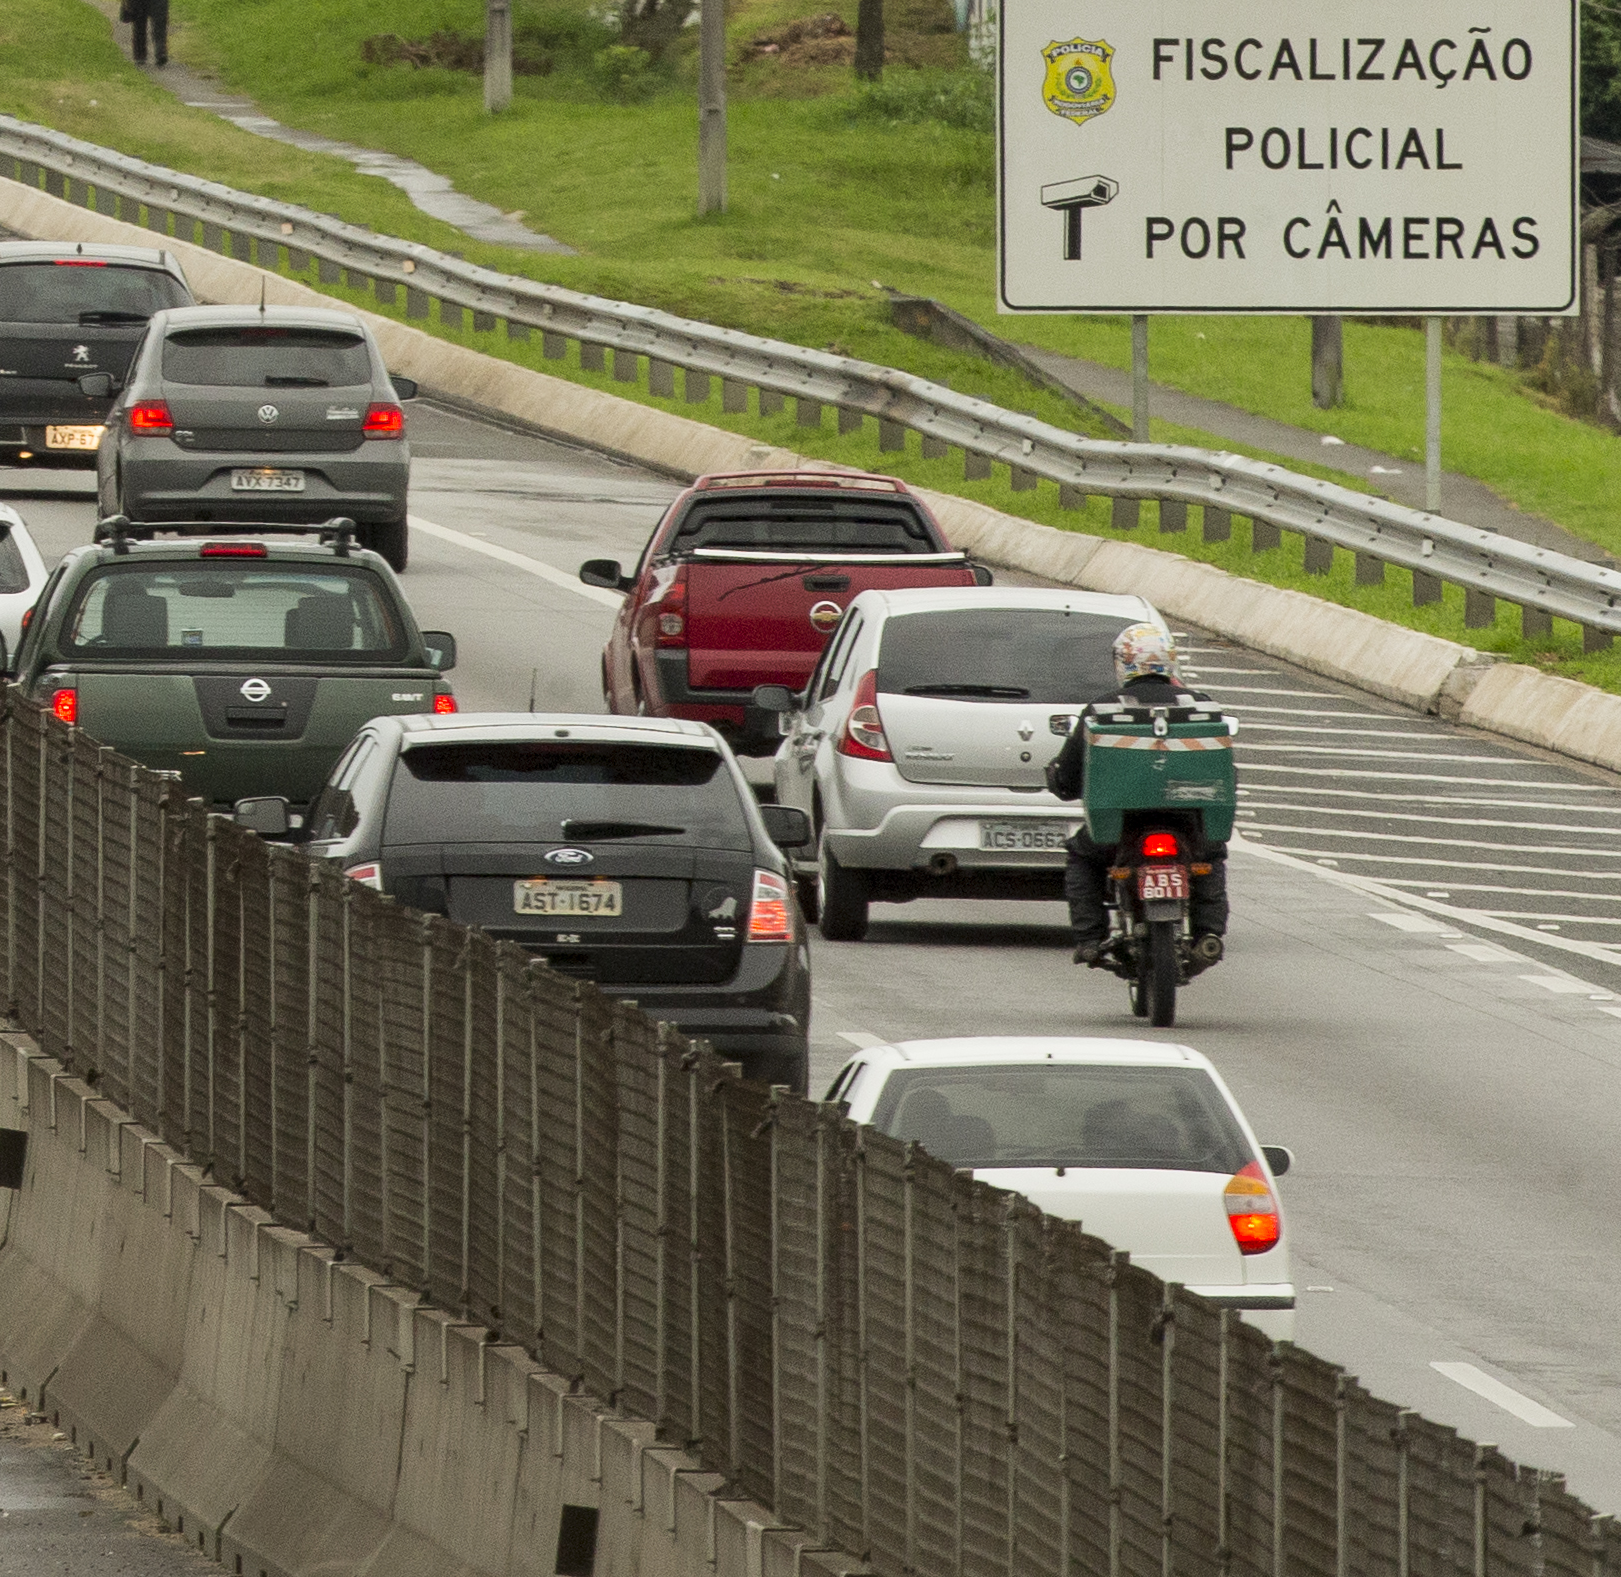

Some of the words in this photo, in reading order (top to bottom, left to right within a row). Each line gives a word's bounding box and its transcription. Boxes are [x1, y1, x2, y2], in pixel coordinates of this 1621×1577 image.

[1152, 26, 1533, 89] FISCALIZAÇÃO
[1224, 126, 1463, 171] POLICIAL
[1145, 216, 1247, 260] POR
[1282, 199, 1541, 260] CÂMERAS
[521, 893, 617, 912] AST-1674
[1144, 873, 1183, 887] ABS
